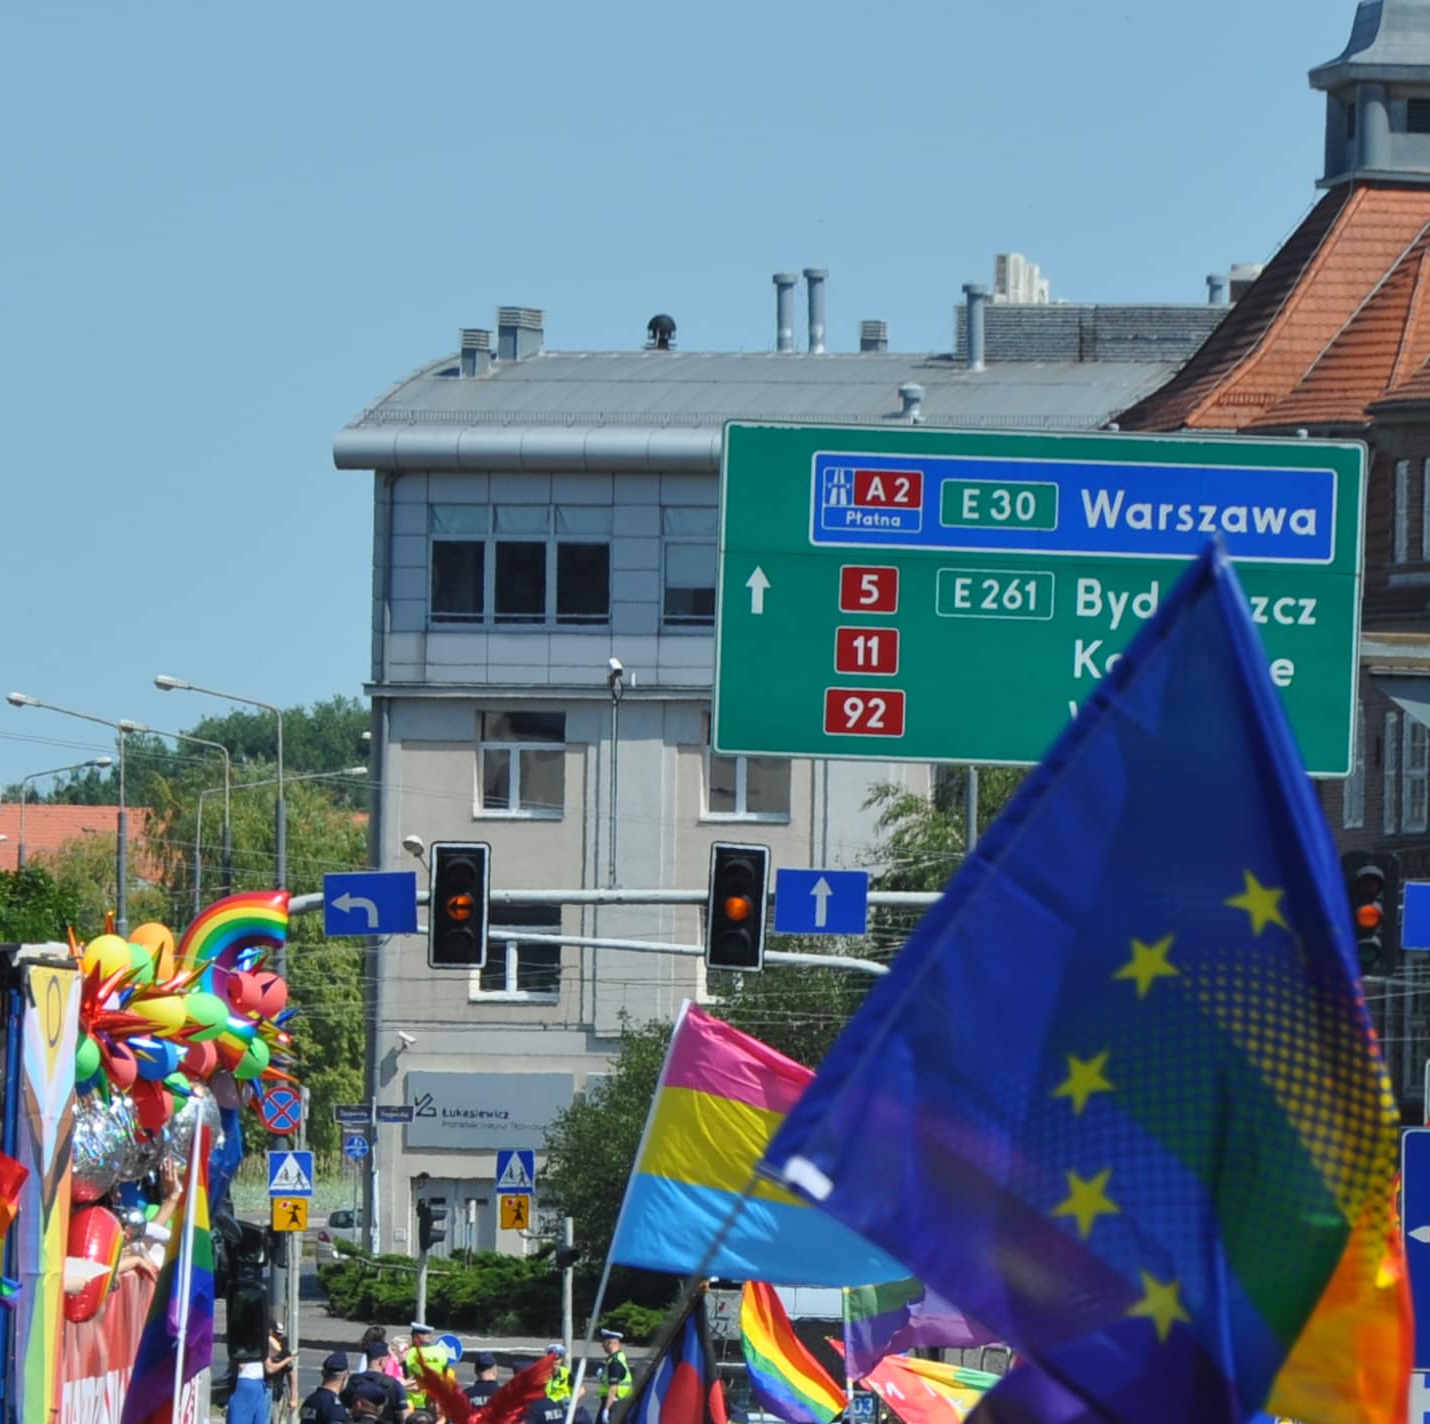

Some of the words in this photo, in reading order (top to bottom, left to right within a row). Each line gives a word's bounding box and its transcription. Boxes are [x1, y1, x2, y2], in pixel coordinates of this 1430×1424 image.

[845, 510, 901, 528] Płatna
[1080, 488, 1317, 536] Warszawa
[859, 574, 879, 605] 5
[1076, 577, 1318, 631] Bydzcz
[852, 635, 879, 667] 11
[843, 696, 887, 729] 92
[441, 1106, 509, 1120] Łukasiewicz
